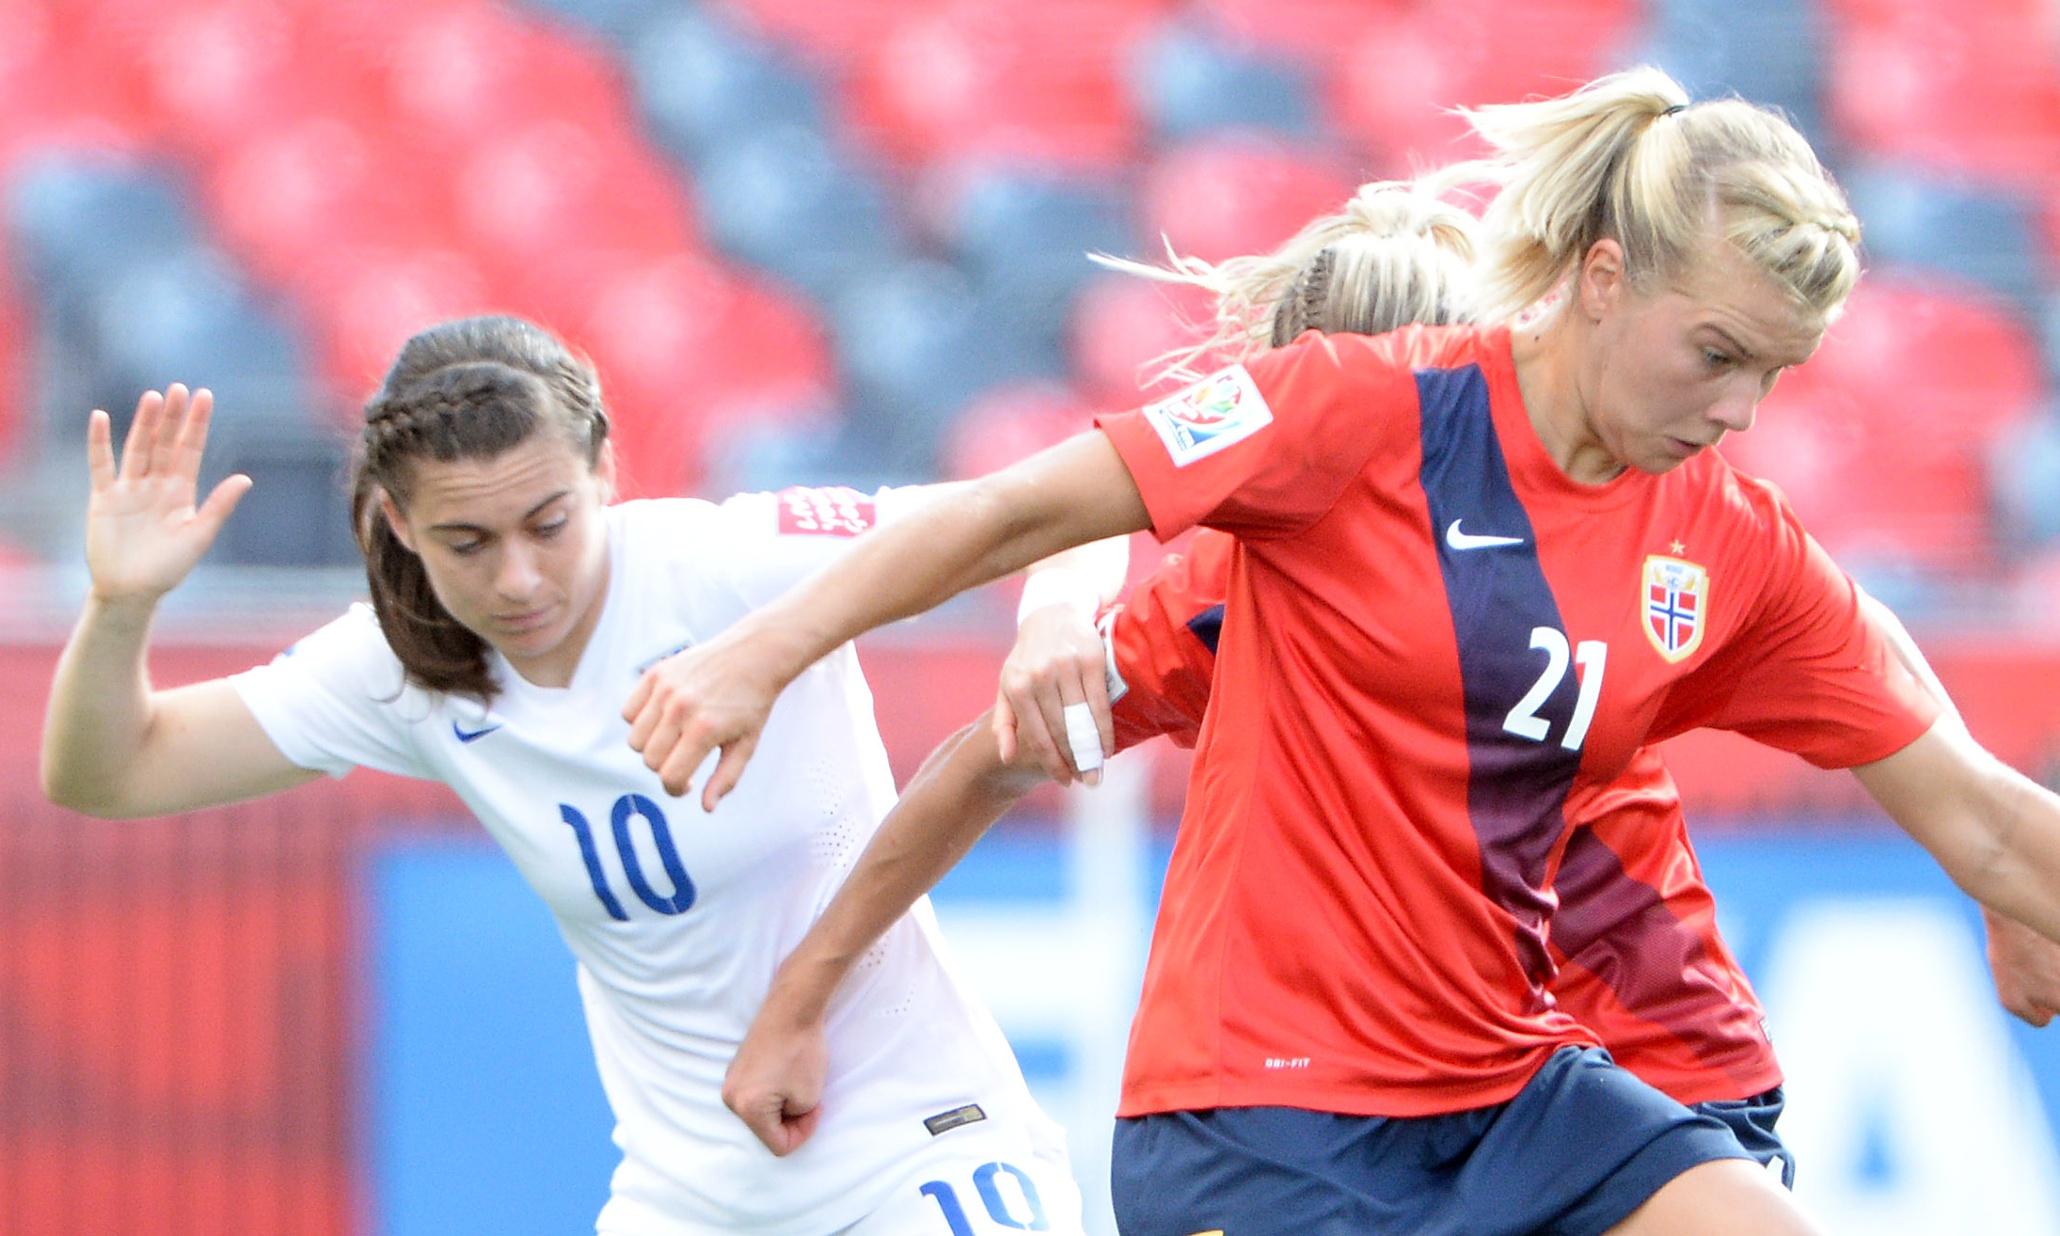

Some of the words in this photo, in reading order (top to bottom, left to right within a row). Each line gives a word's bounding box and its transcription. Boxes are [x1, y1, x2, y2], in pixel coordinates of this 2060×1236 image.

[1502, 626, 1608, 751] 21
[559, 793, 696, 921] 10
[919, 1161, 1050, 1236] 10
